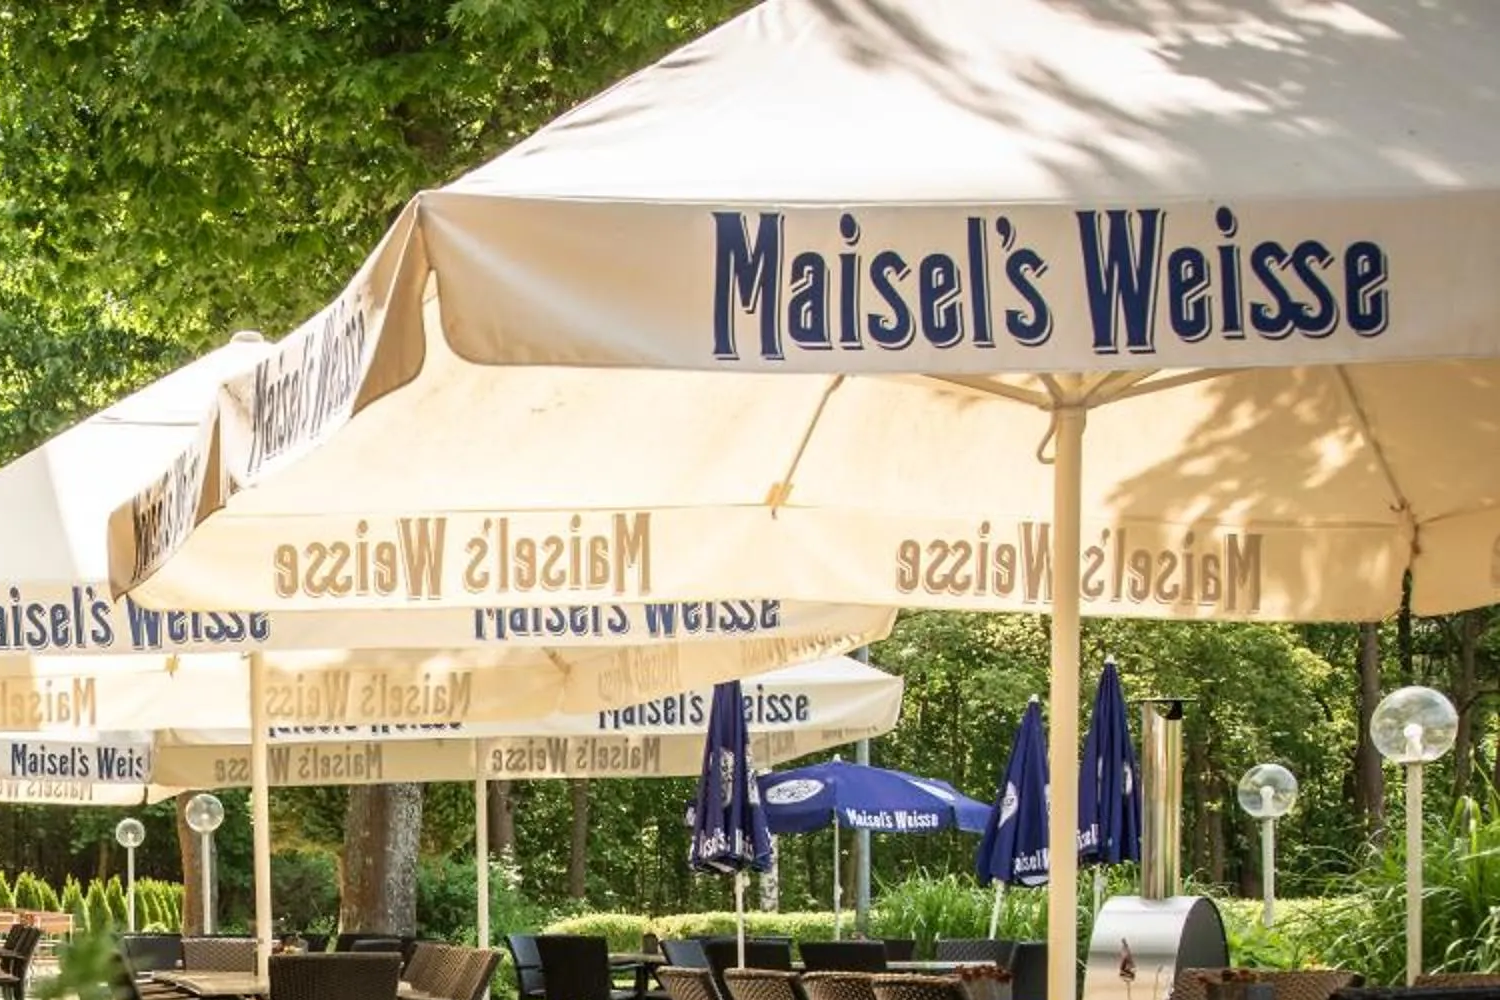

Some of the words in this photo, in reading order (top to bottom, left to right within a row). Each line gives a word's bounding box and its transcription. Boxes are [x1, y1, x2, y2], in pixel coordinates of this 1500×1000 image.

[712, 207, 1053, 361] Maisel's
[1075, 206, 1389, 355] Weisse
[474, 604, 631, 641] Maisels
[744, 683, 811, 724] eisse
[11, 743, 89, 777] Maisel's
[97, 747, 143, 780] Weis
[845, 807, 893, 829] Maisel's
